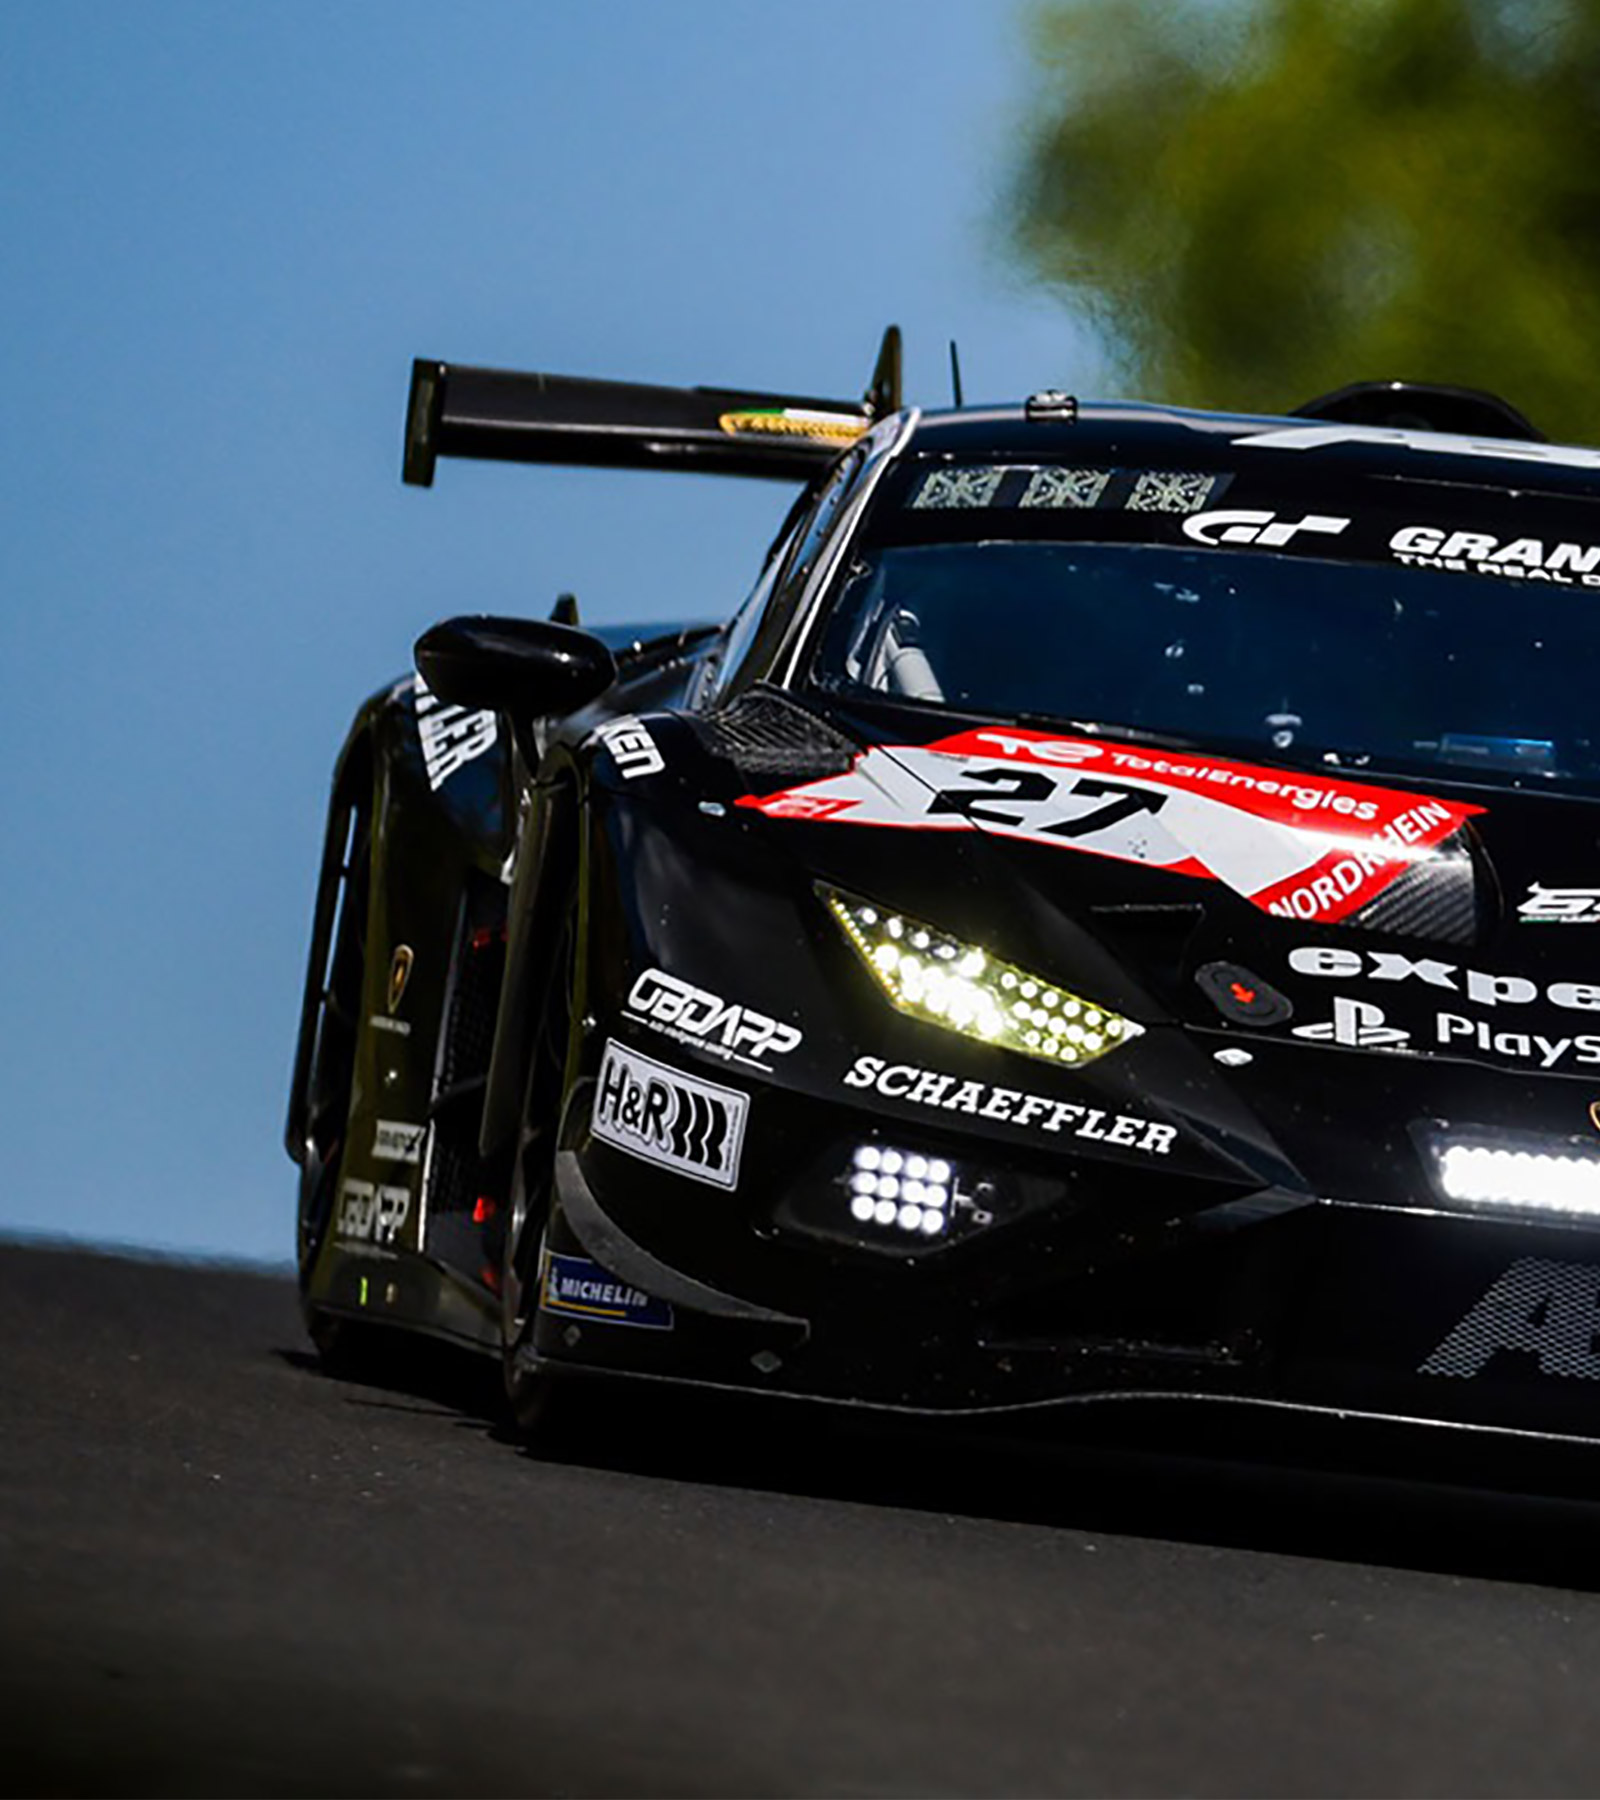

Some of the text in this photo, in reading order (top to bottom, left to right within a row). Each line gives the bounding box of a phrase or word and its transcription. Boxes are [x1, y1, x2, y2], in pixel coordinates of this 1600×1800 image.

[1393, 552, 1467, 572] THE
[1477, 561, 1573, 584] REAL
[926, 768, 1169, 838] 27
[1110, 752, 1380, 820] TotalEnergies
[843, 1055, 1179, 1155] SCHAEFFLER
